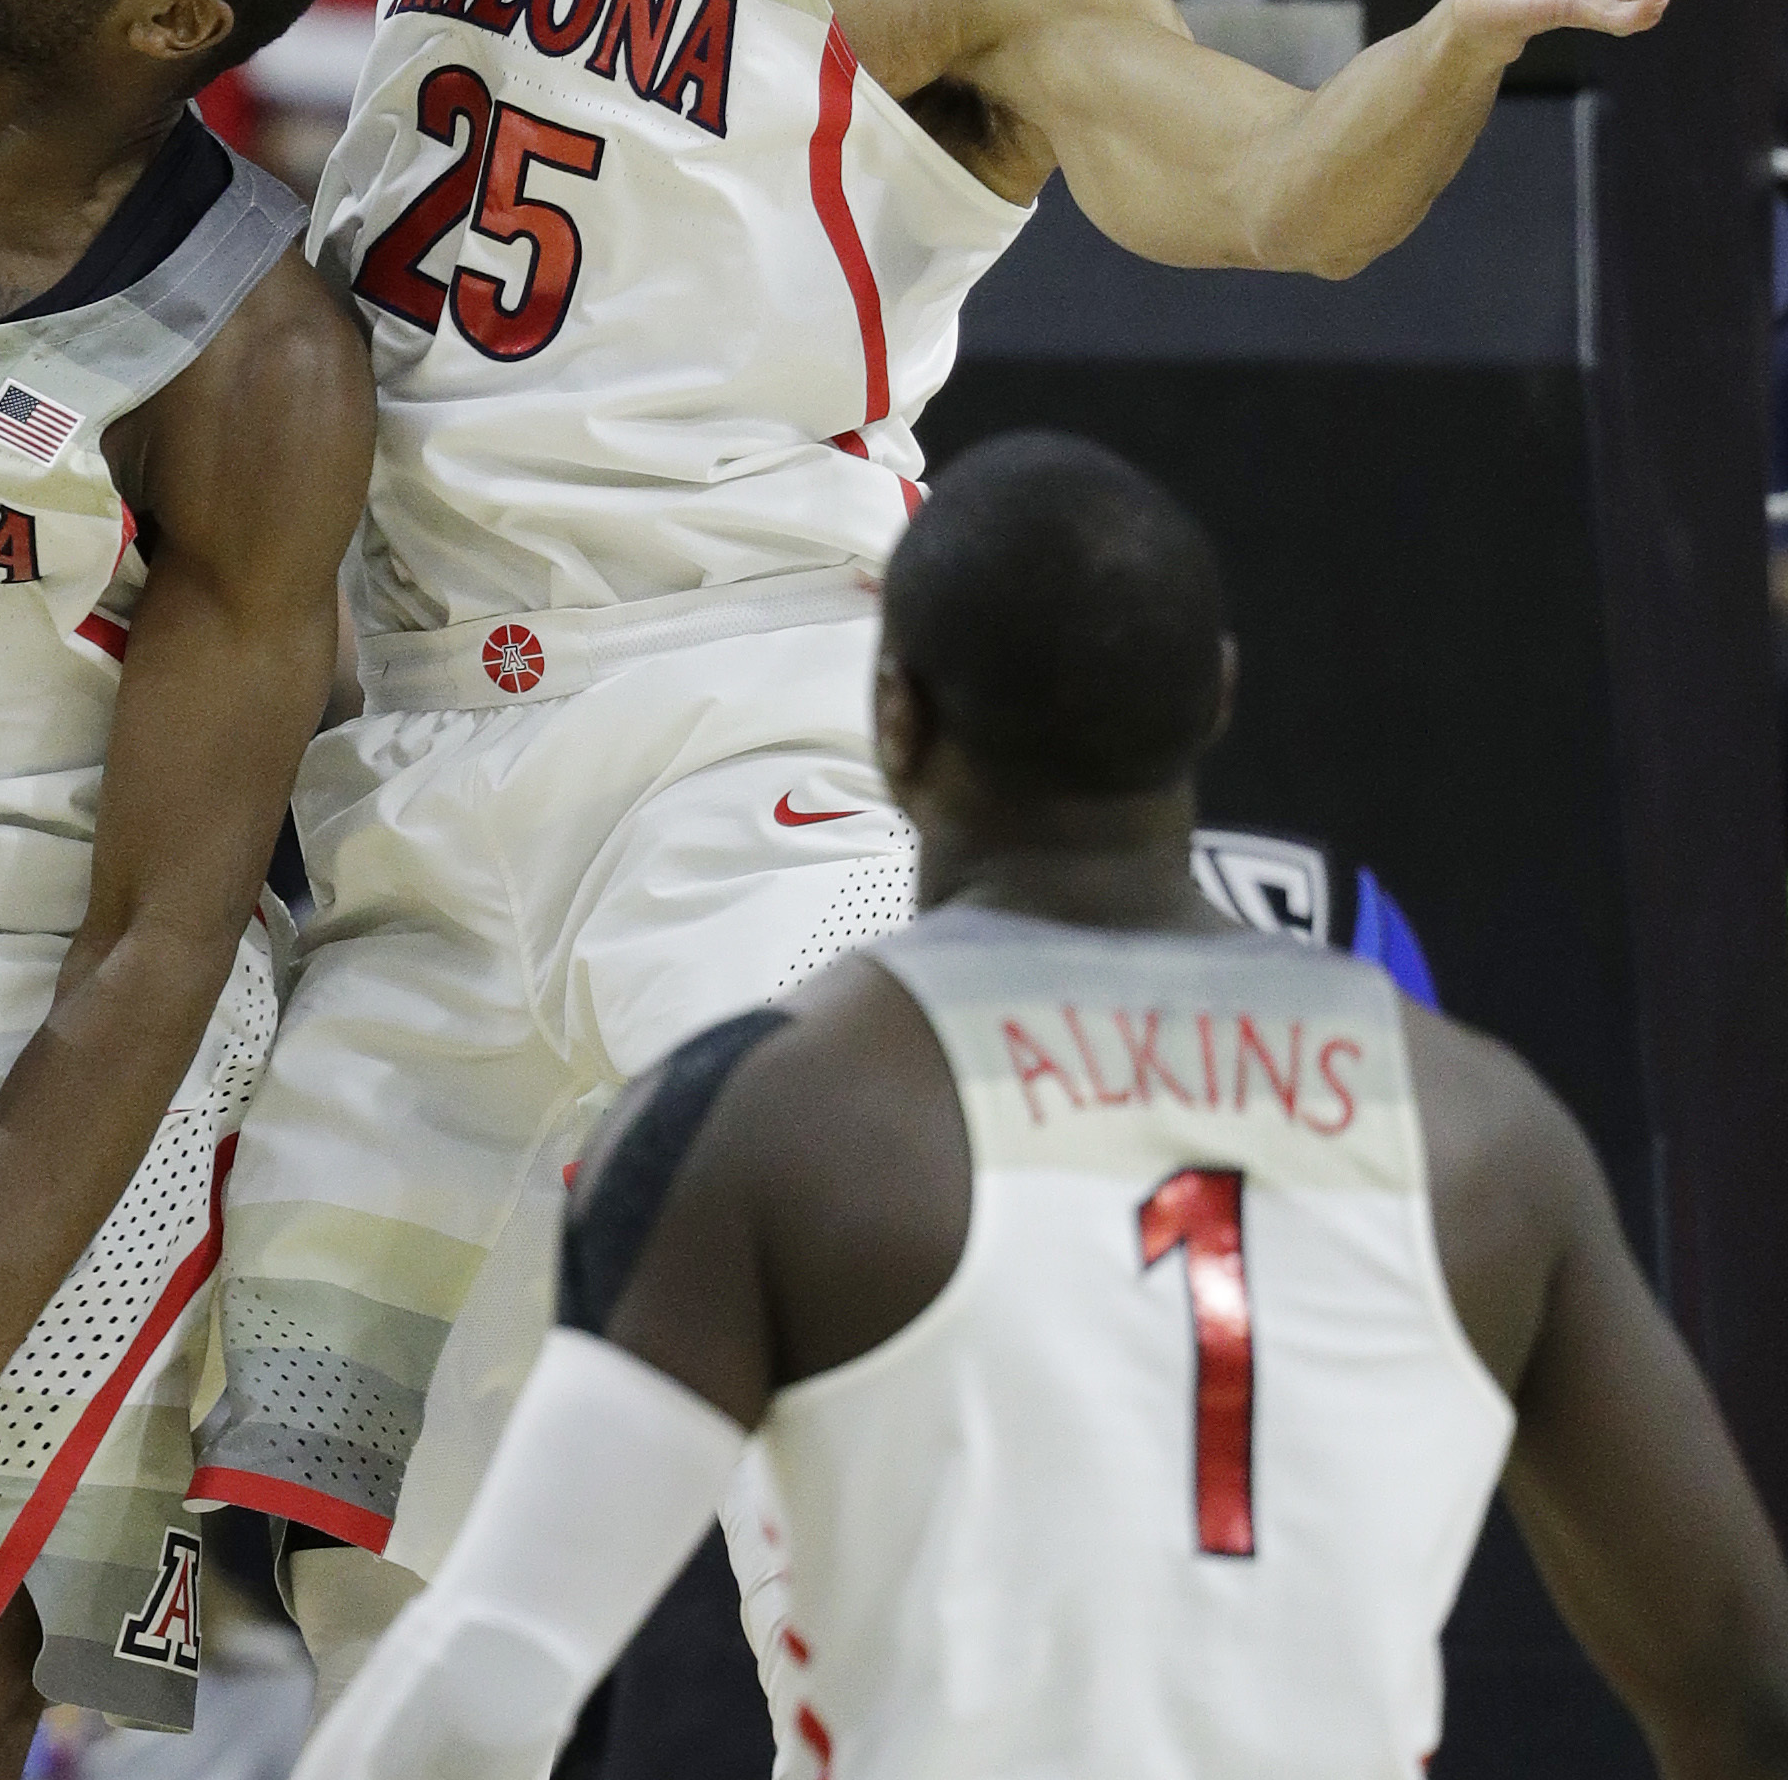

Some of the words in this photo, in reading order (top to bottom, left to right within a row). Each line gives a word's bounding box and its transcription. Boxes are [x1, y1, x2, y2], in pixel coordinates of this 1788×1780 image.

[351, 64, 605, 362] 25
[501, 644, 528, 674] A
[1000, 1005, 1362, 1137] ALKINS
[1138, 1166, 1256, 1558] 1
[114, 1525, 202, 1678] A
